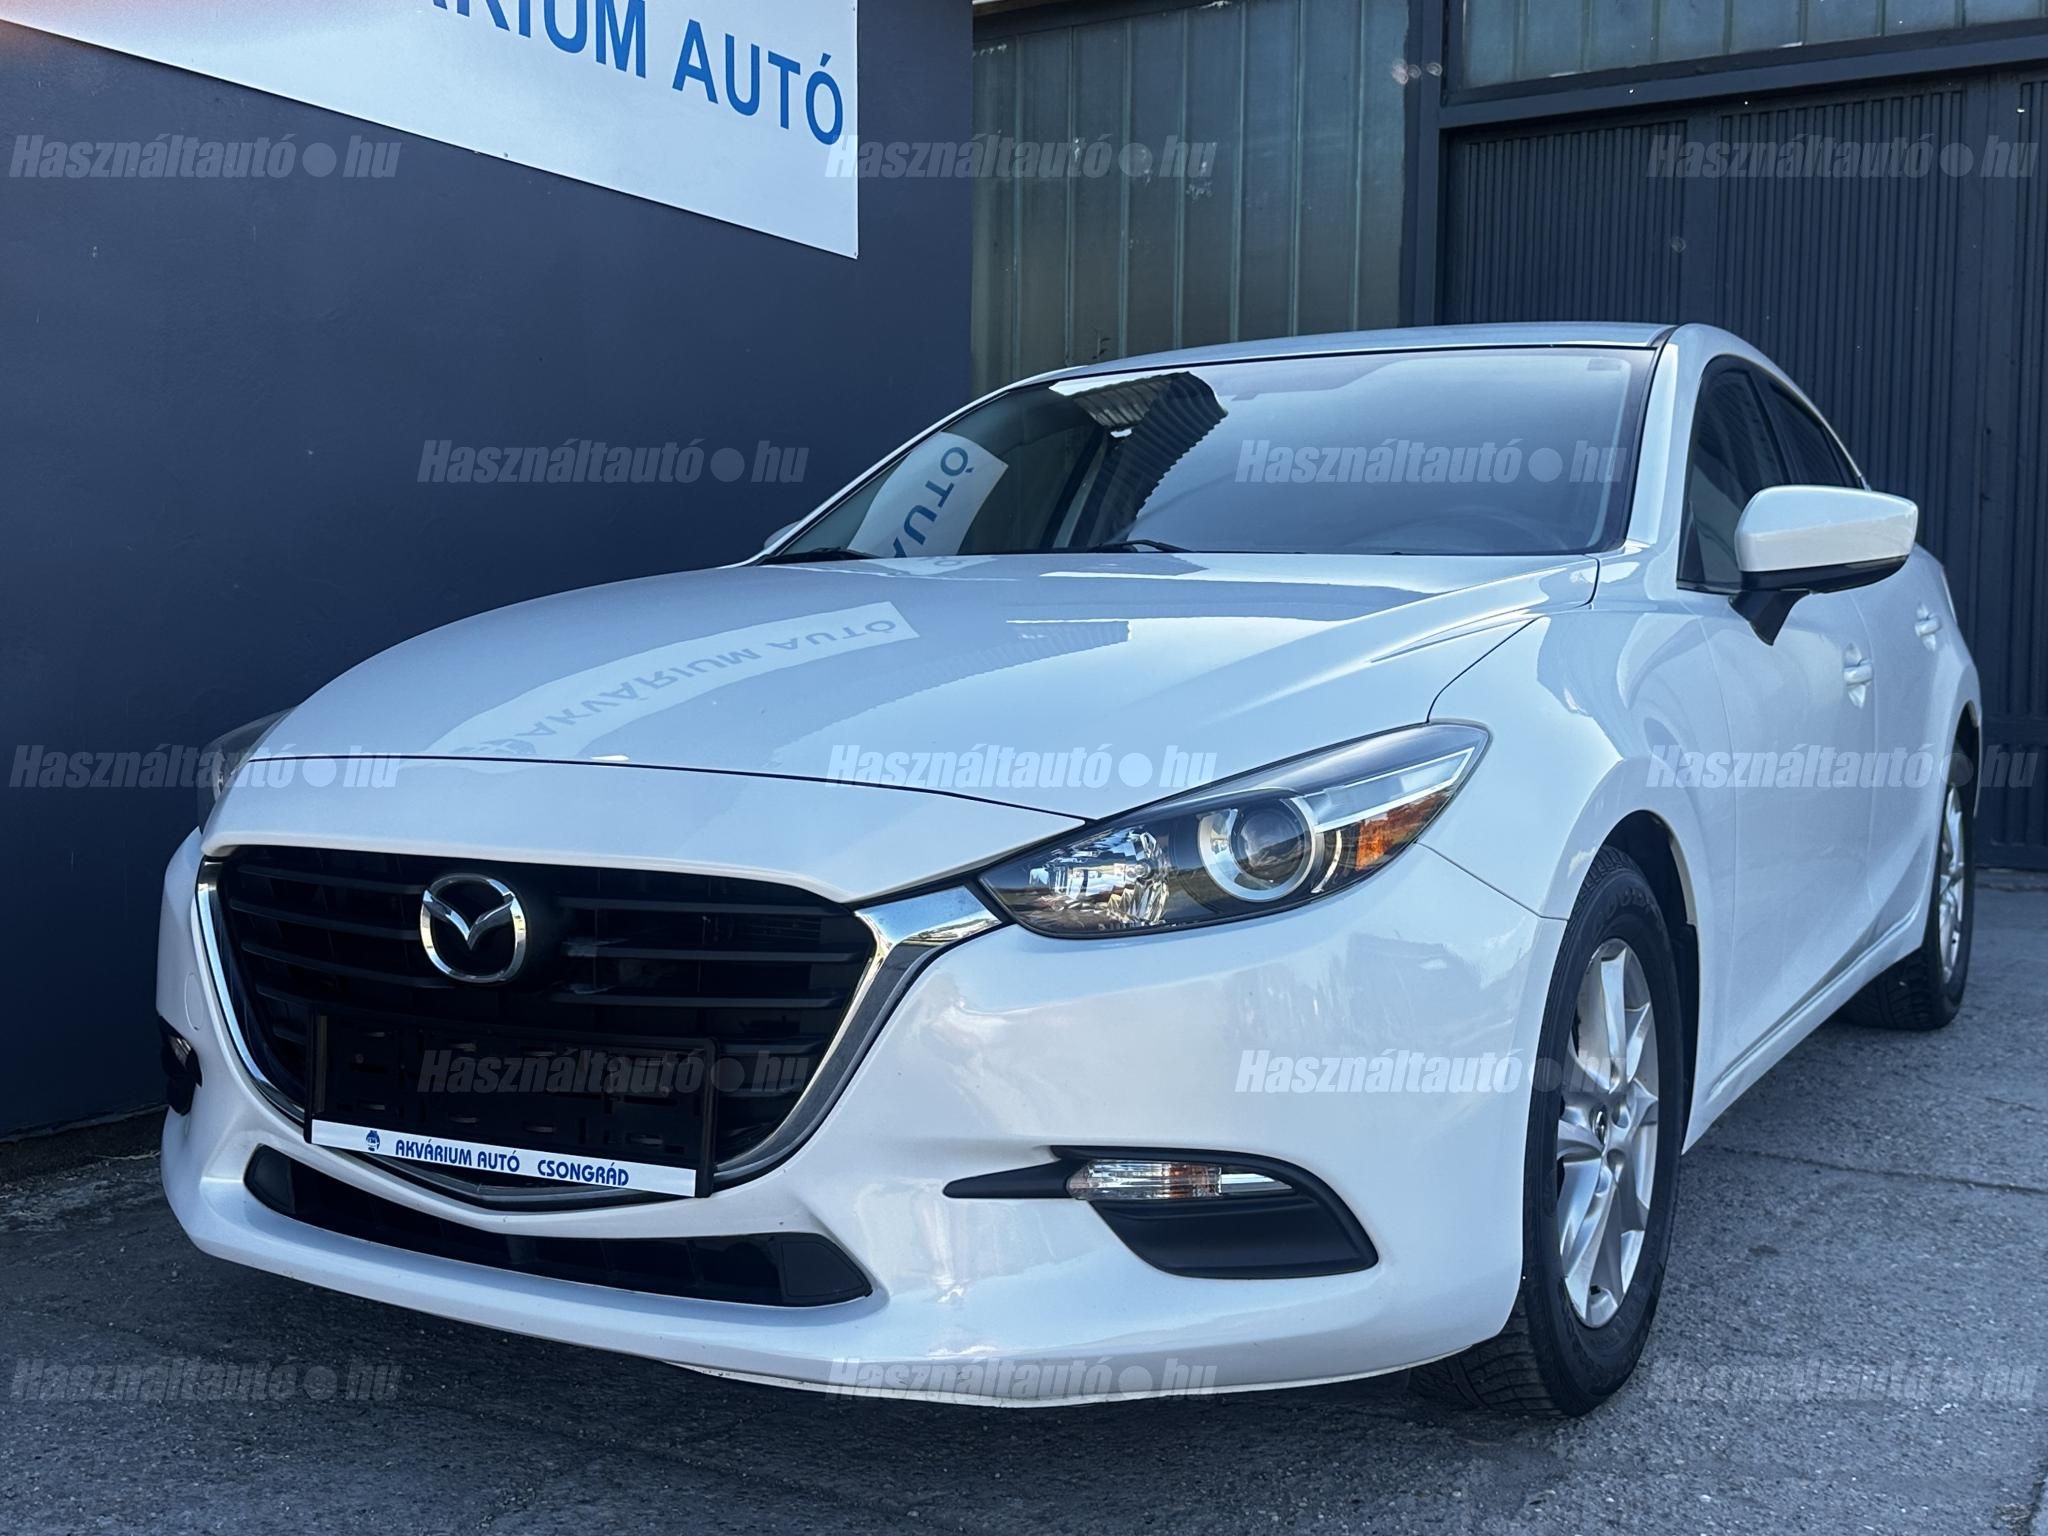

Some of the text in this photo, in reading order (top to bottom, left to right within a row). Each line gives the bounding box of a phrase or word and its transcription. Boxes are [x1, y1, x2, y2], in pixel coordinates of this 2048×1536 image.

[672, 20, 843, 146] AUTÓ
[395, 1138, 629, 1187] AKVÁRIUM AUTÓ CSONGRÁD
